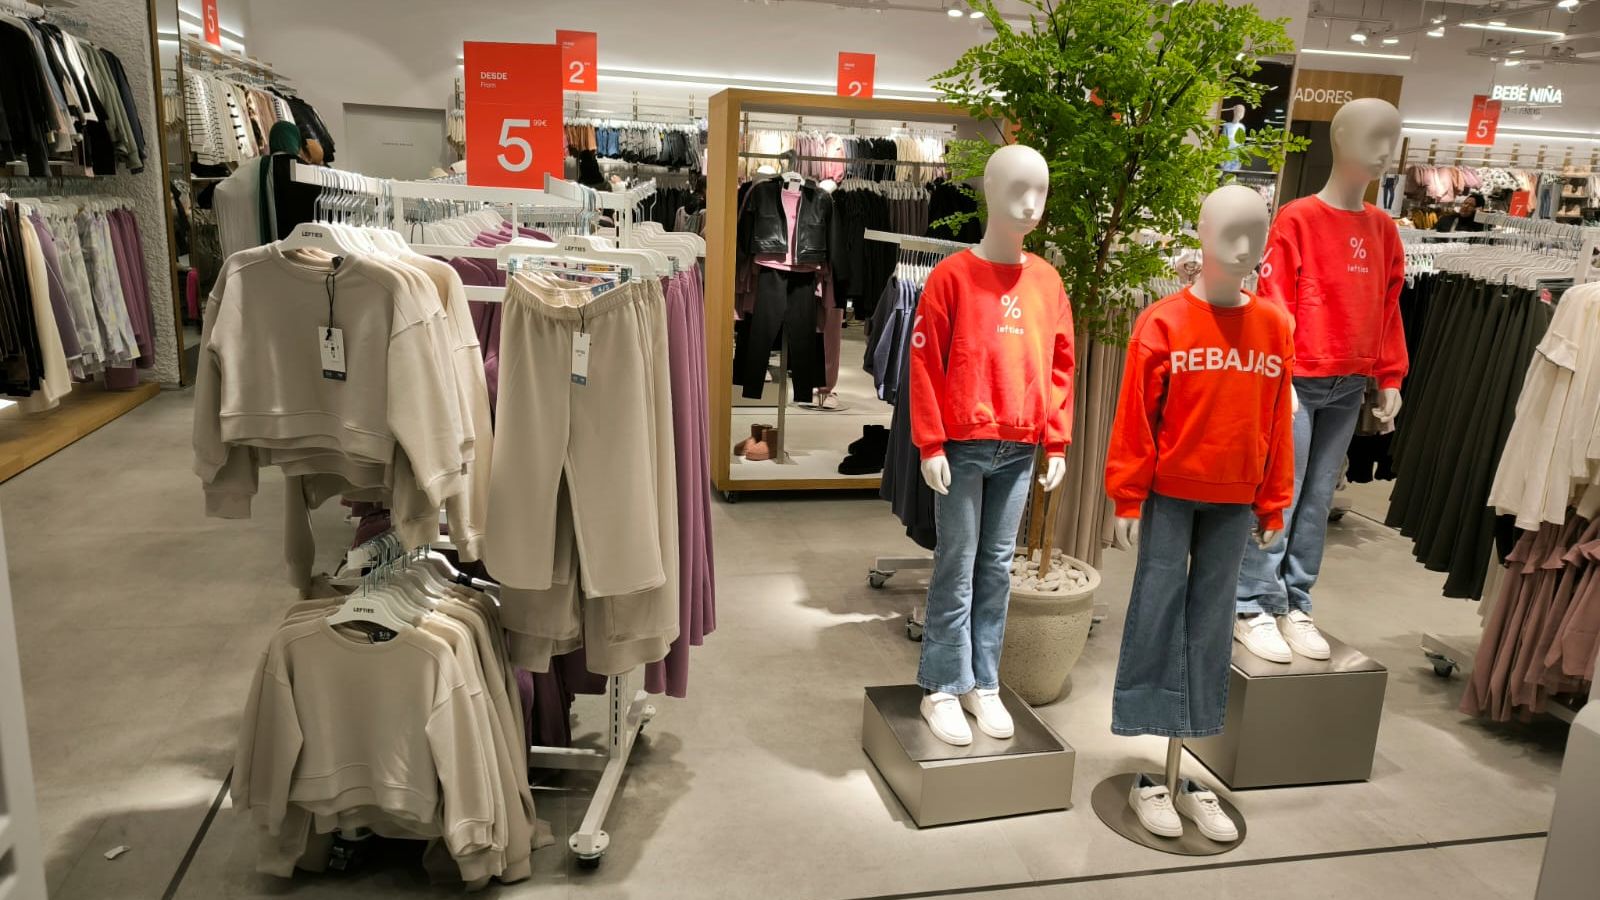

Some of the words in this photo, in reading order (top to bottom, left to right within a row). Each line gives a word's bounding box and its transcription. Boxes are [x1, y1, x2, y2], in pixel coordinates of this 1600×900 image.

[207, 4, 216, 33] 5
[480, 72, 508, 80] DESDE
[569, 60, 585, 84] 2
[480, 81, 497, 89] From
[1492, 84, 1529, 101] BEBÉ
[1528, 85, 1563, 104] NIÑA
[1295, 87, 1353, 104] ADORES
[1476, 119, 1489, 138] 5
[496, 118, 533, 172] 5
[1347, 263, 1369, 273] lefties
[996, 324, 1025, 335] lefties
[1170, 346, 1282, 378] REBAJAS
